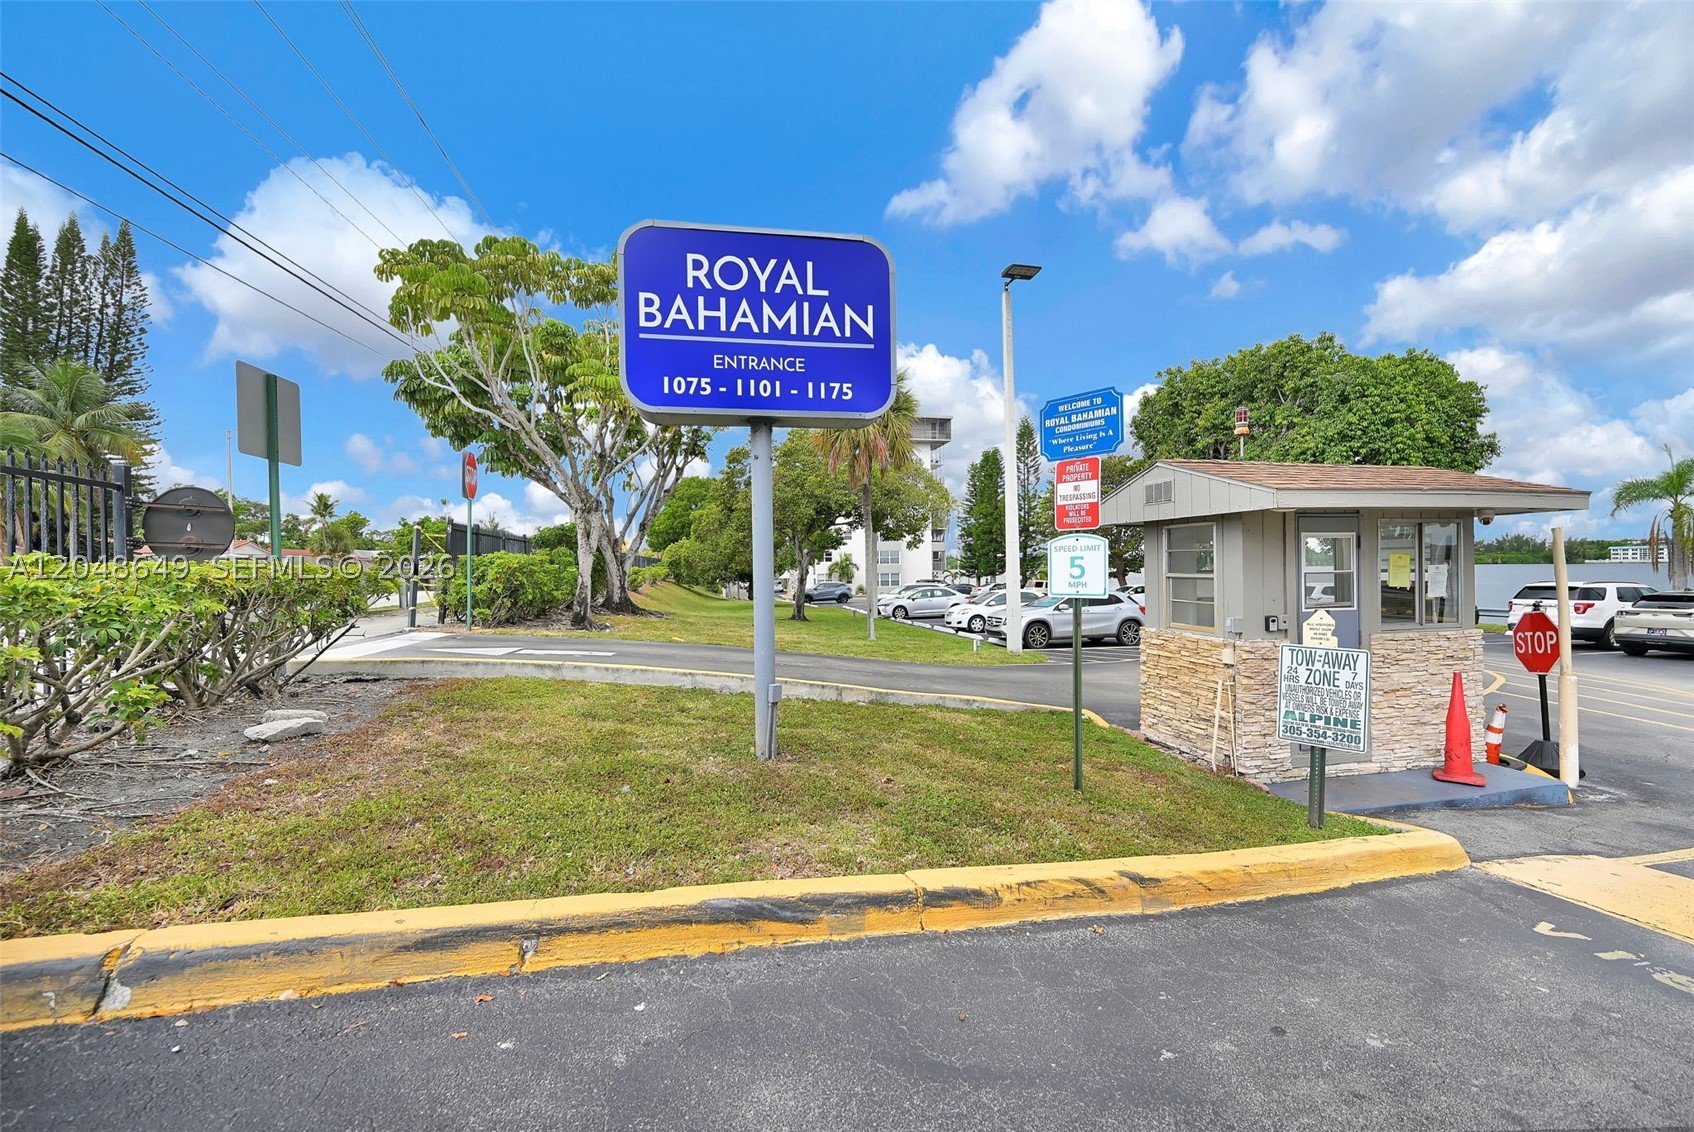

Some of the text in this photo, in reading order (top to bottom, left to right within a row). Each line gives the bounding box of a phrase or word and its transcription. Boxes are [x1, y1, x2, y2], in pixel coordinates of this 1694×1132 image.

[686, 252, 830, 297] ROYAL
[638, 291, 875, 339] BAHAMIAN
[713, 354, 806, 372] ENTRANCE
[662, 376, 712, 396] 1075
[736, 379, 780, 398] 1101
[808, 380, 853, 400] 1175
[1058, 397, 1102, 412] WELCOME TO
[1045, 406, 1117, 428] ROYAL BAHAMIAN
[1055, 418, 1105, 434] CONDOMINIUMS
[1076, 432, 1098, 442] Living
[1062, 472, 1092, 482] PROPERTY
[1066, 462, 1090, 474] PRIVATE
[1059, 492, 1096, 502] TRESPASSING
[1063, 516, 1092, 524] PROSECUTED
[1069, 556, 1086, 580] 5
[1516, 630, 1557, 655] STOP
[1288, 648, 1360, 671] TOW-AWAY
[1284, 674, 1300, 684] HRS
[1286, 666, 1298, 674] 24
[1305, 668, 1340, 688] ZONE
[1351, 672, 1358, 680] 7
[1285, 683, 1362, 700] UNAUTHORIZED VEHICLES OR
[1345, 680, 1364, 690] DAYS
[1282, 692, 1364, 710] VESSELS WILL BE TOWED AWAY
[1284, 701, 1360, 719] AT OWNERS RISK & EXPENSE
[1283, 710, 1361, 730] ALPINE
[1282, 724, 1361, 745] 305-354-3200
